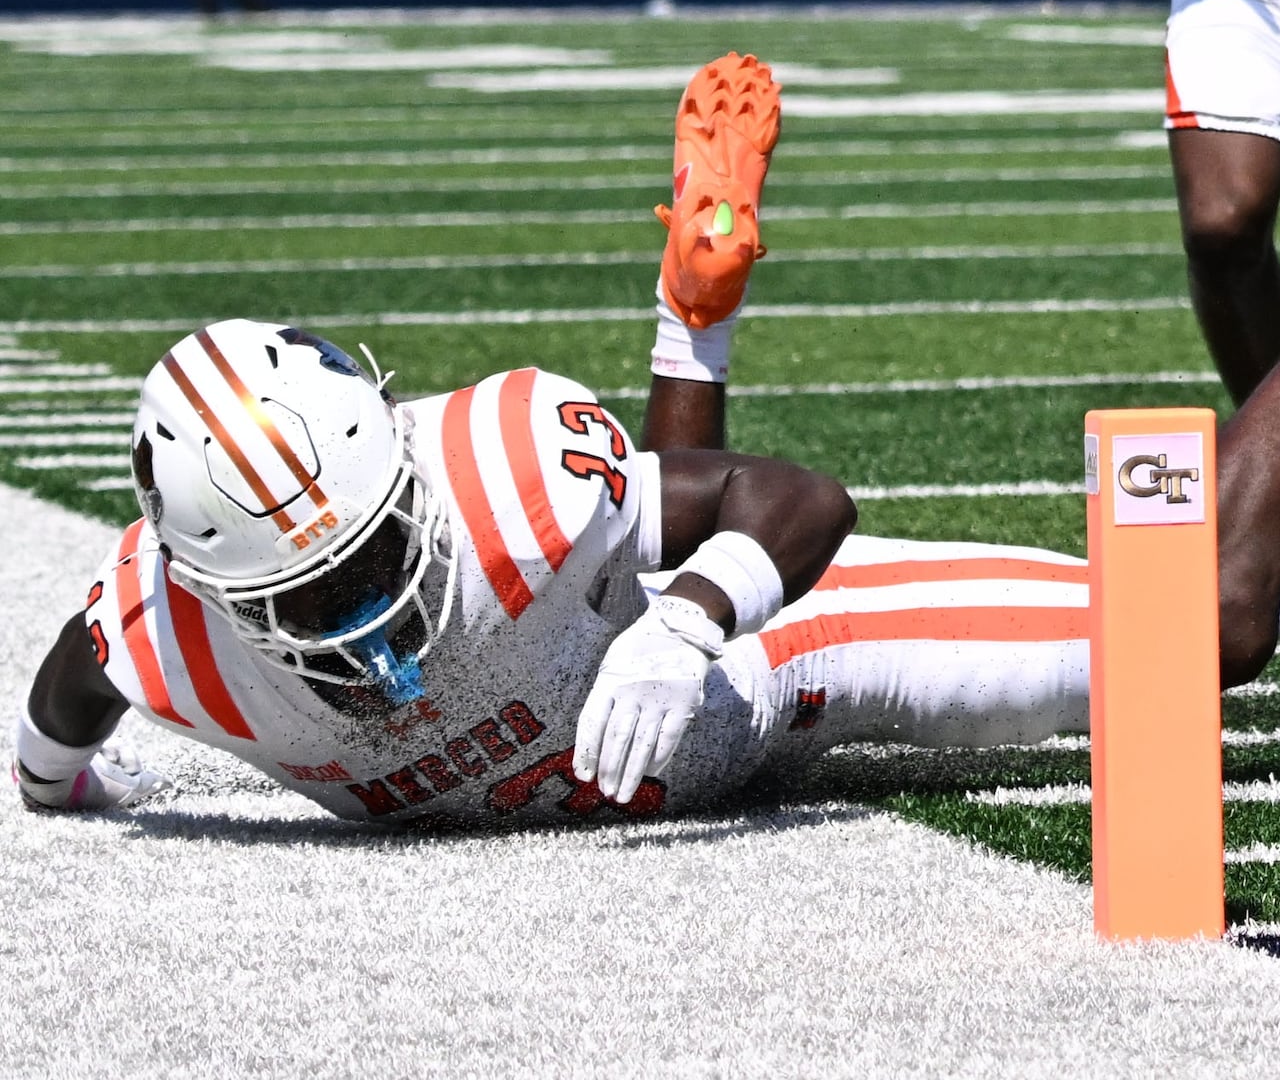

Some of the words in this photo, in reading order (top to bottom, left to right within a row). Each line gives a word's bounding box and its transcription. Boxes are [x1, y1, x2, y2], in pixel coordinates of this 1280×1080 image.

[555, 400, 628, 512] 13
[1117, 453, 1199, 505] GT
[290, 510, 339, 551] BTB
[347, 700, 547, 817] MERCER
